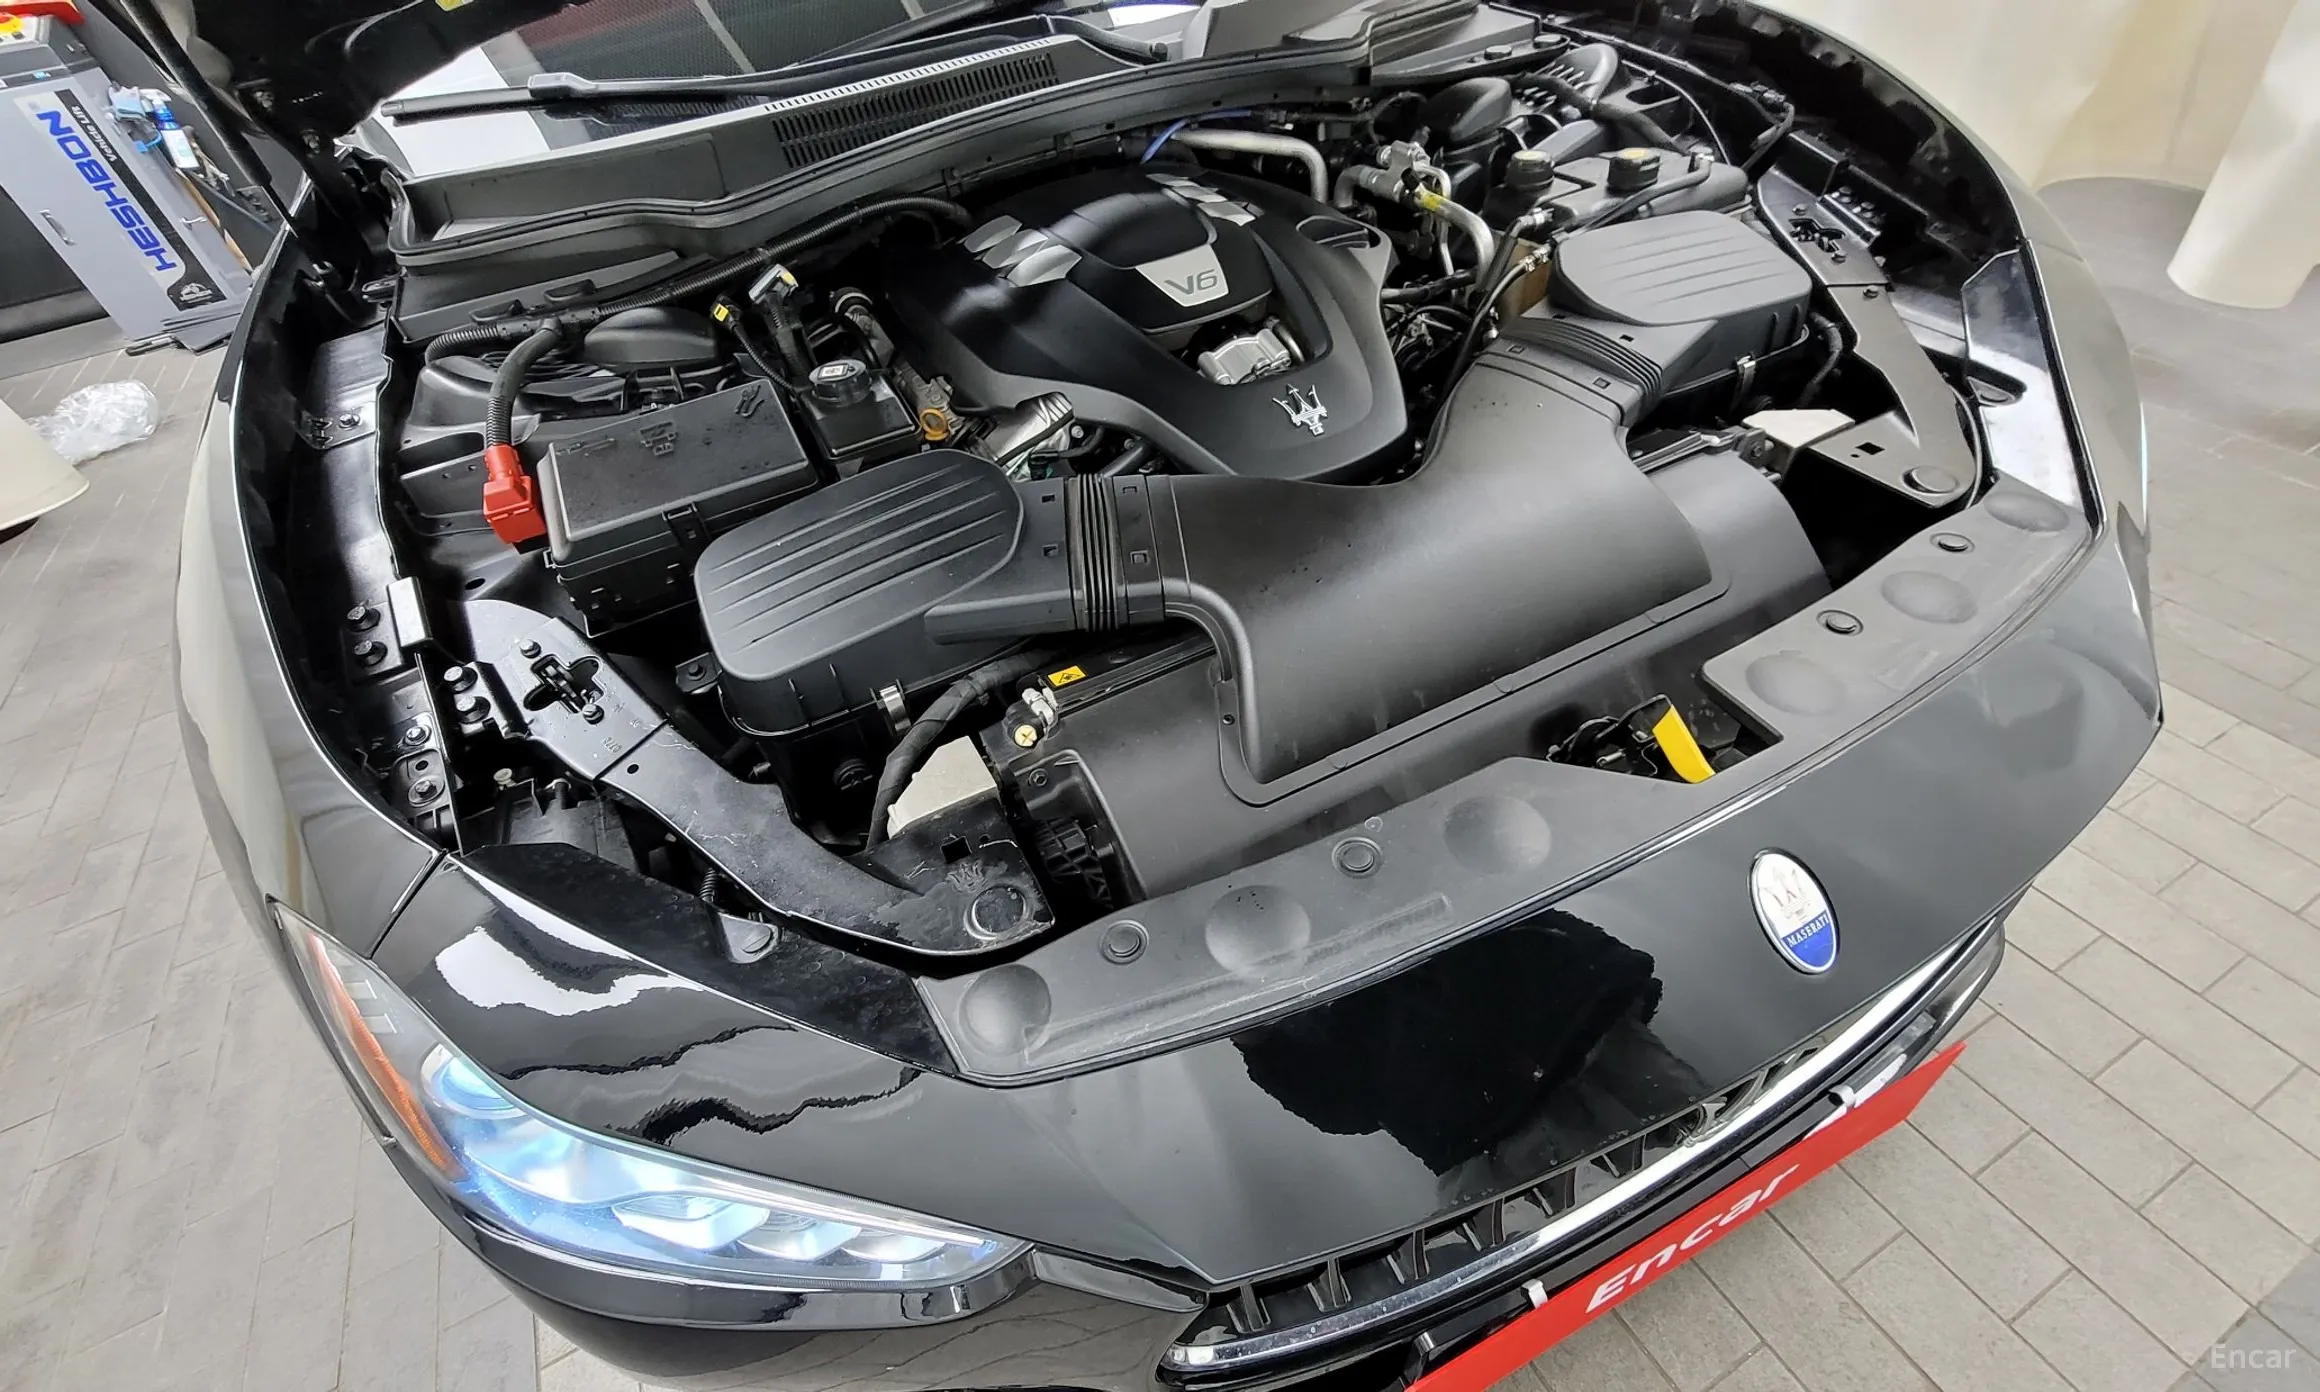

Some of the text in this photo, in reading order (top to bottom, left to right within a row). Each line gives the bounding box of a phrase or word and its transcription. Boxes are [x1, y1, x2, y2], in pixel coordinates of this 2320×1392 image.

[71, 106, 117, 161] Vehicle Lift
[36, 110, 177, 271] HESHBON
[1164, 269, 1217, 295] V6
[1787, 914, 1829, 948] MASERATI
[1585, 1164, 1799, 1313] Encar
